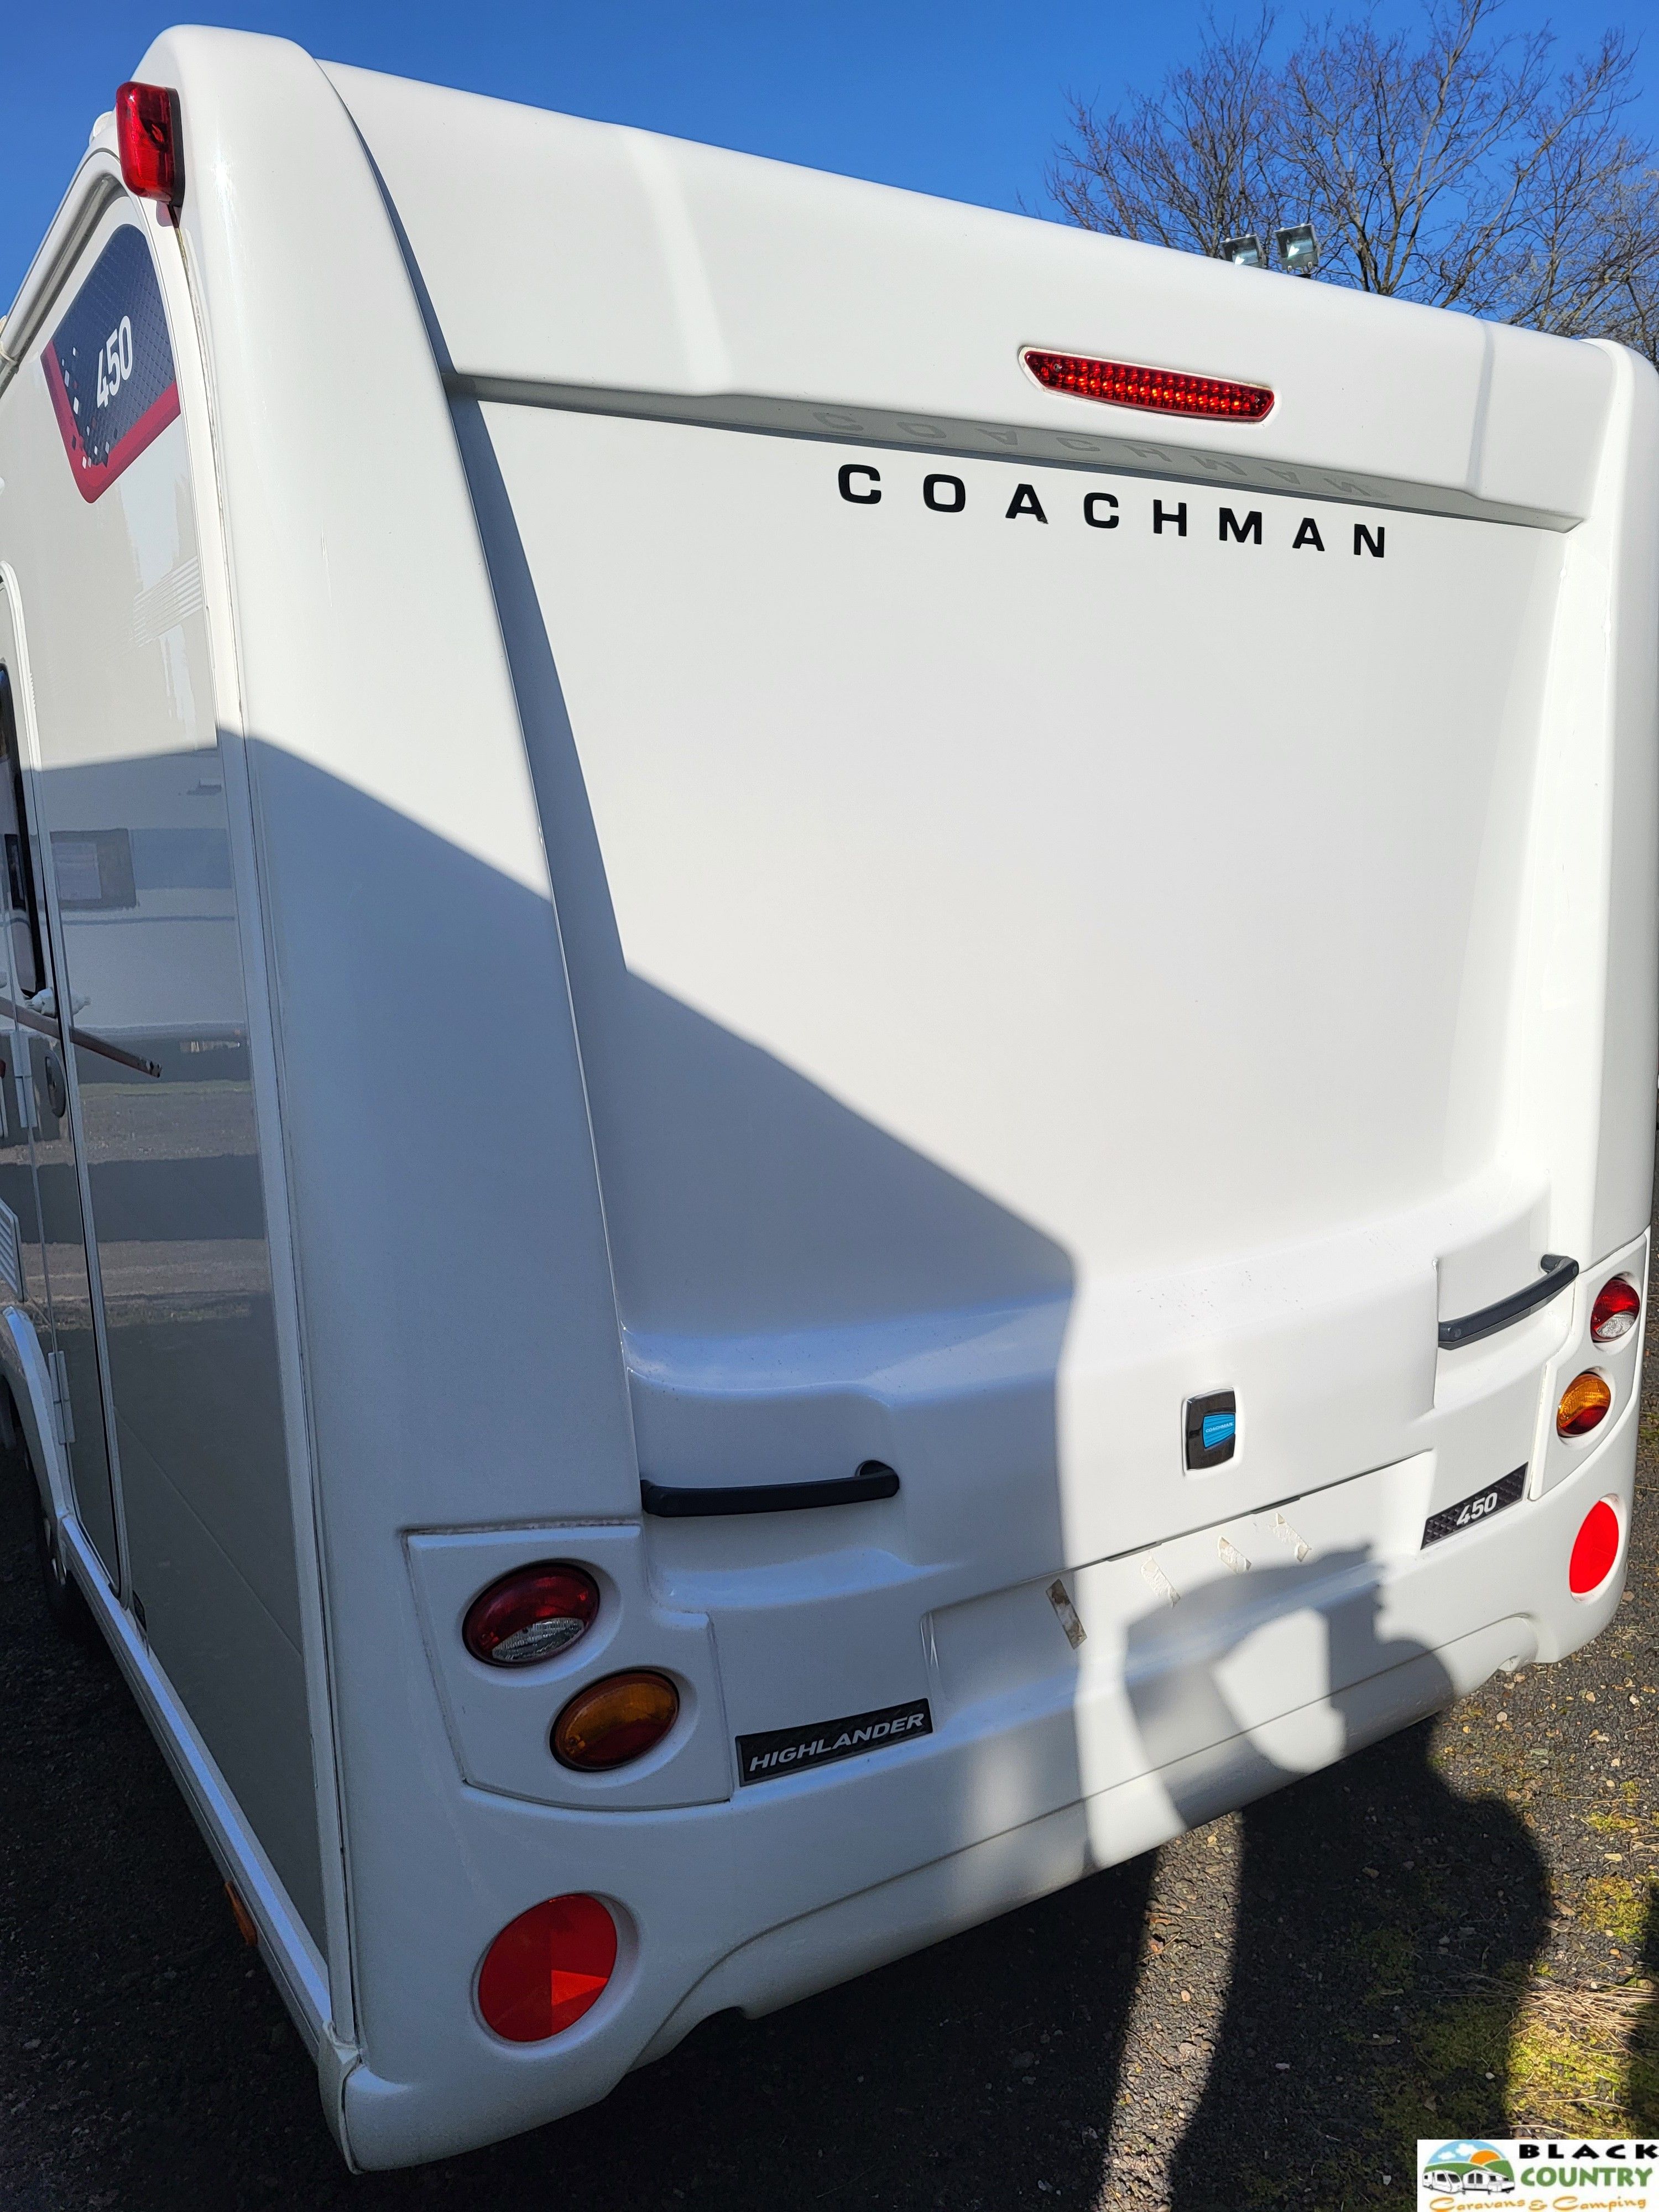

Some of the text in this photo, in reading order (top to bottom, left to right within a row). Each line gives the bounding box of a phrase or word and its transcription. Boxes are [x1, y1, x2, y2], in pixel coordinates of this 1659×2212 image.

[96, 315, 133, 408] 450
[838, 463, 1385, 557] COACHMAN
[1205, 1422, 1234, 1433] COACHMAN
[1456, 1492, 1498, 1526] 450
[749, 1713, 925, 1771] HIGHLANDER
